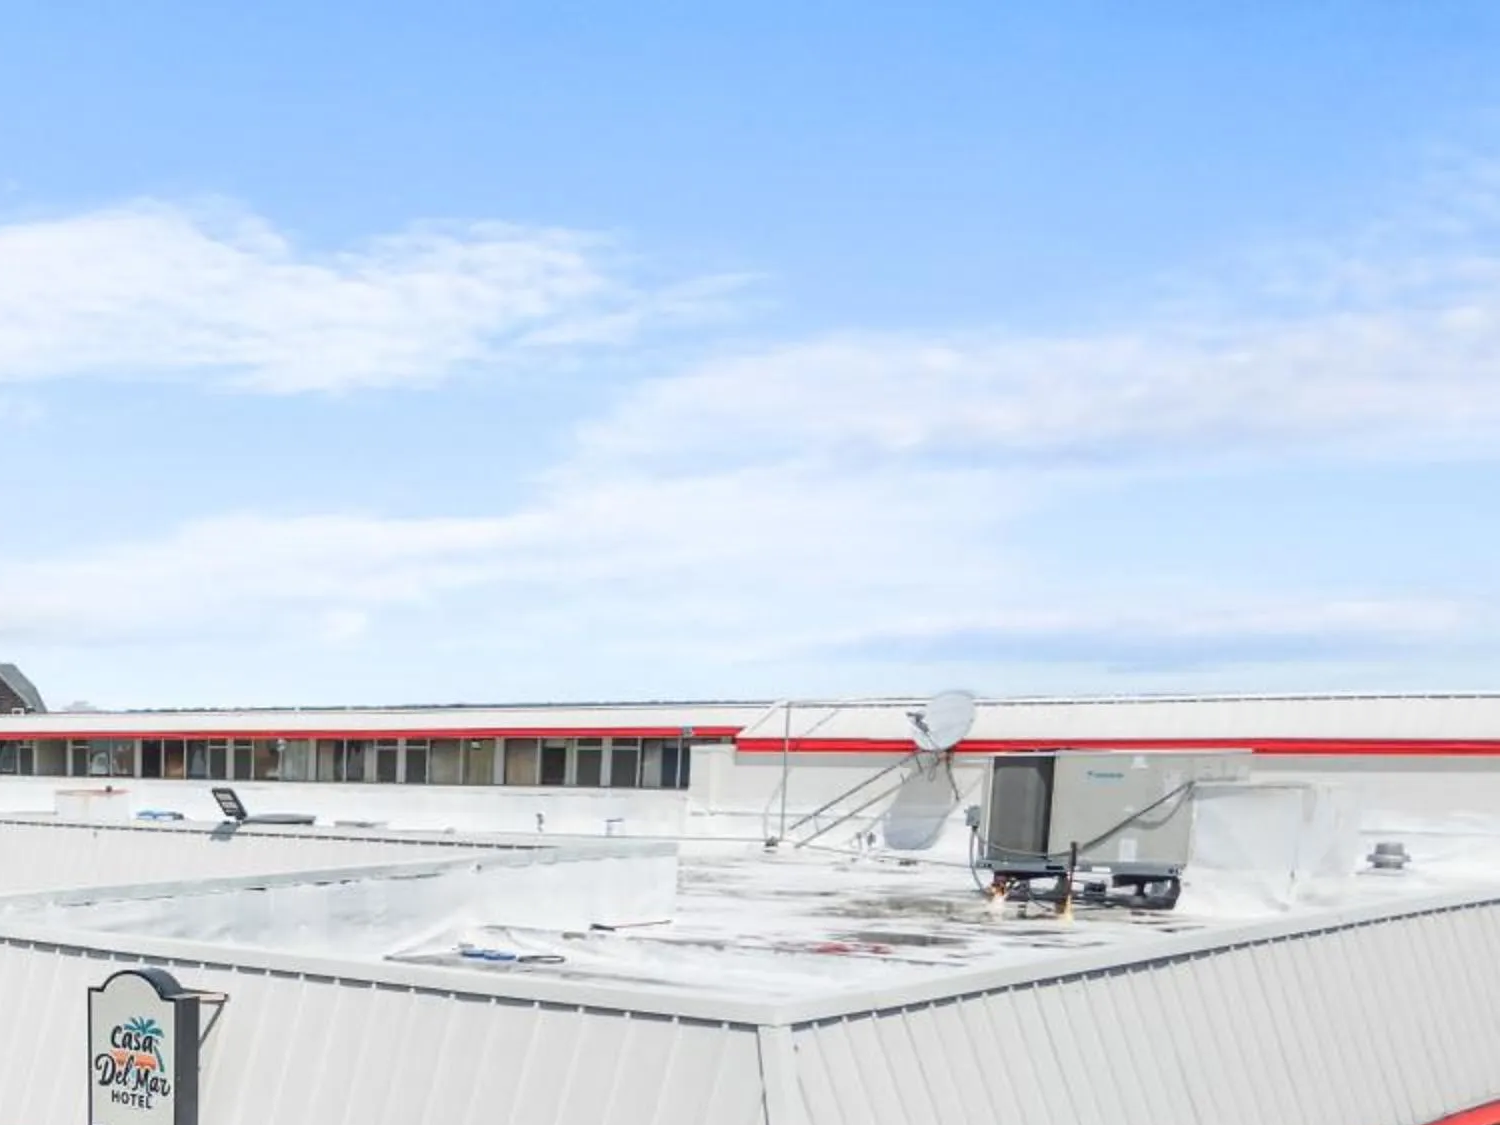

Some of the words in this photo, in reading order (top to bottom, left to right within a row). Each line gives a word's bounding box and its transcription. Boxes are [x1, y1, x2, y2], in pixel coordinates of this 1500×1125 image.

[111, 1025, 154, 1053] Casa
[95, 1053, 135, 1086] Del
[132, 1068, 171, 1097] Mar
[111, 1089, 153, 1109] HOTEL
